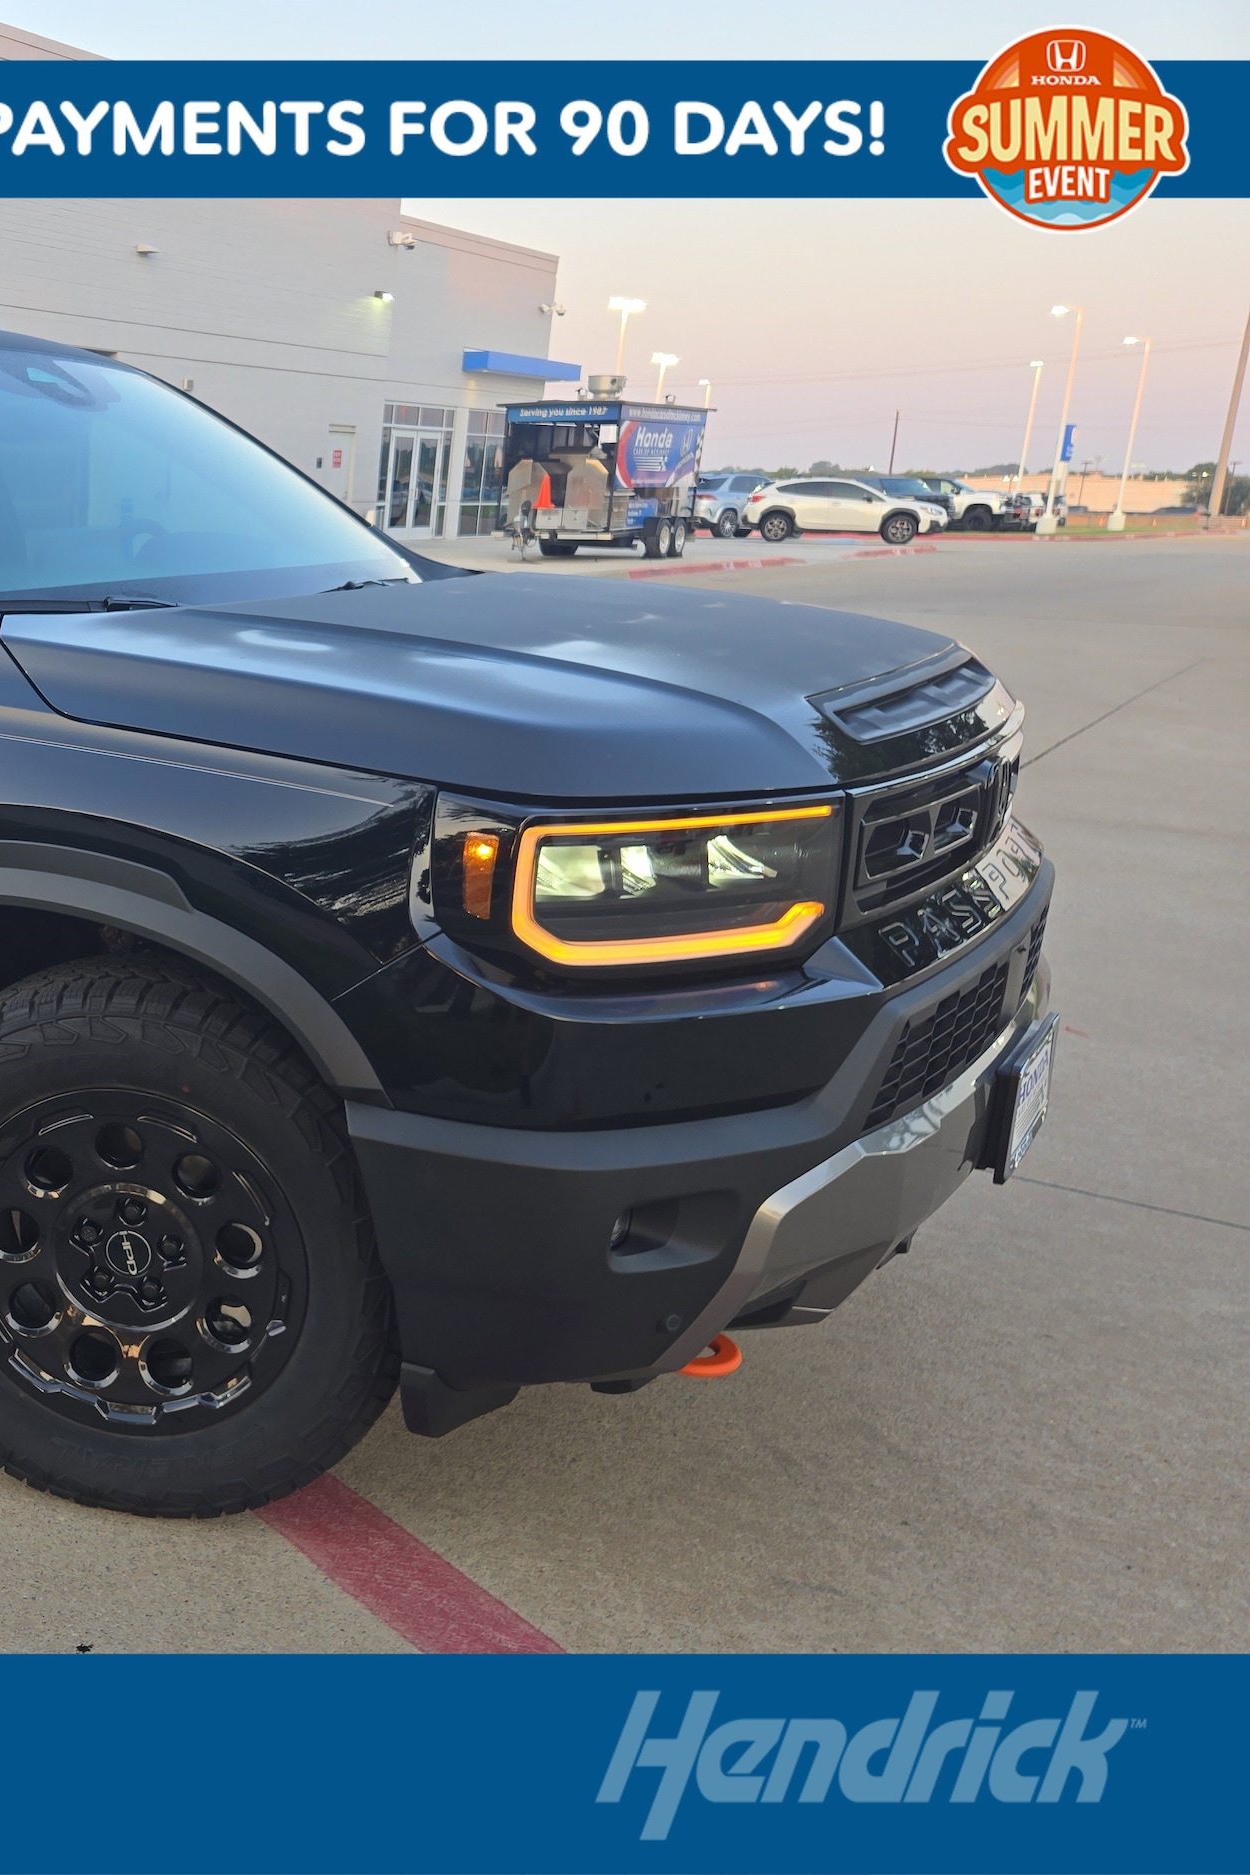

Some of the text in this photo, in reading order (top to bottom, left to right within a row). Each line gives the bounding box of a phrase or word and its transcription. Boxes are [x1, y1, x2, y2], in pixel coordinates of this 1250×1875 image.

[519, 408, 548, 418] Serving
[548, 408, 565, 417] you
[565, 407, 587, 416] since
[634, 426, 673, 448] Honda
[119, 1230, 138, 1275] HPD
